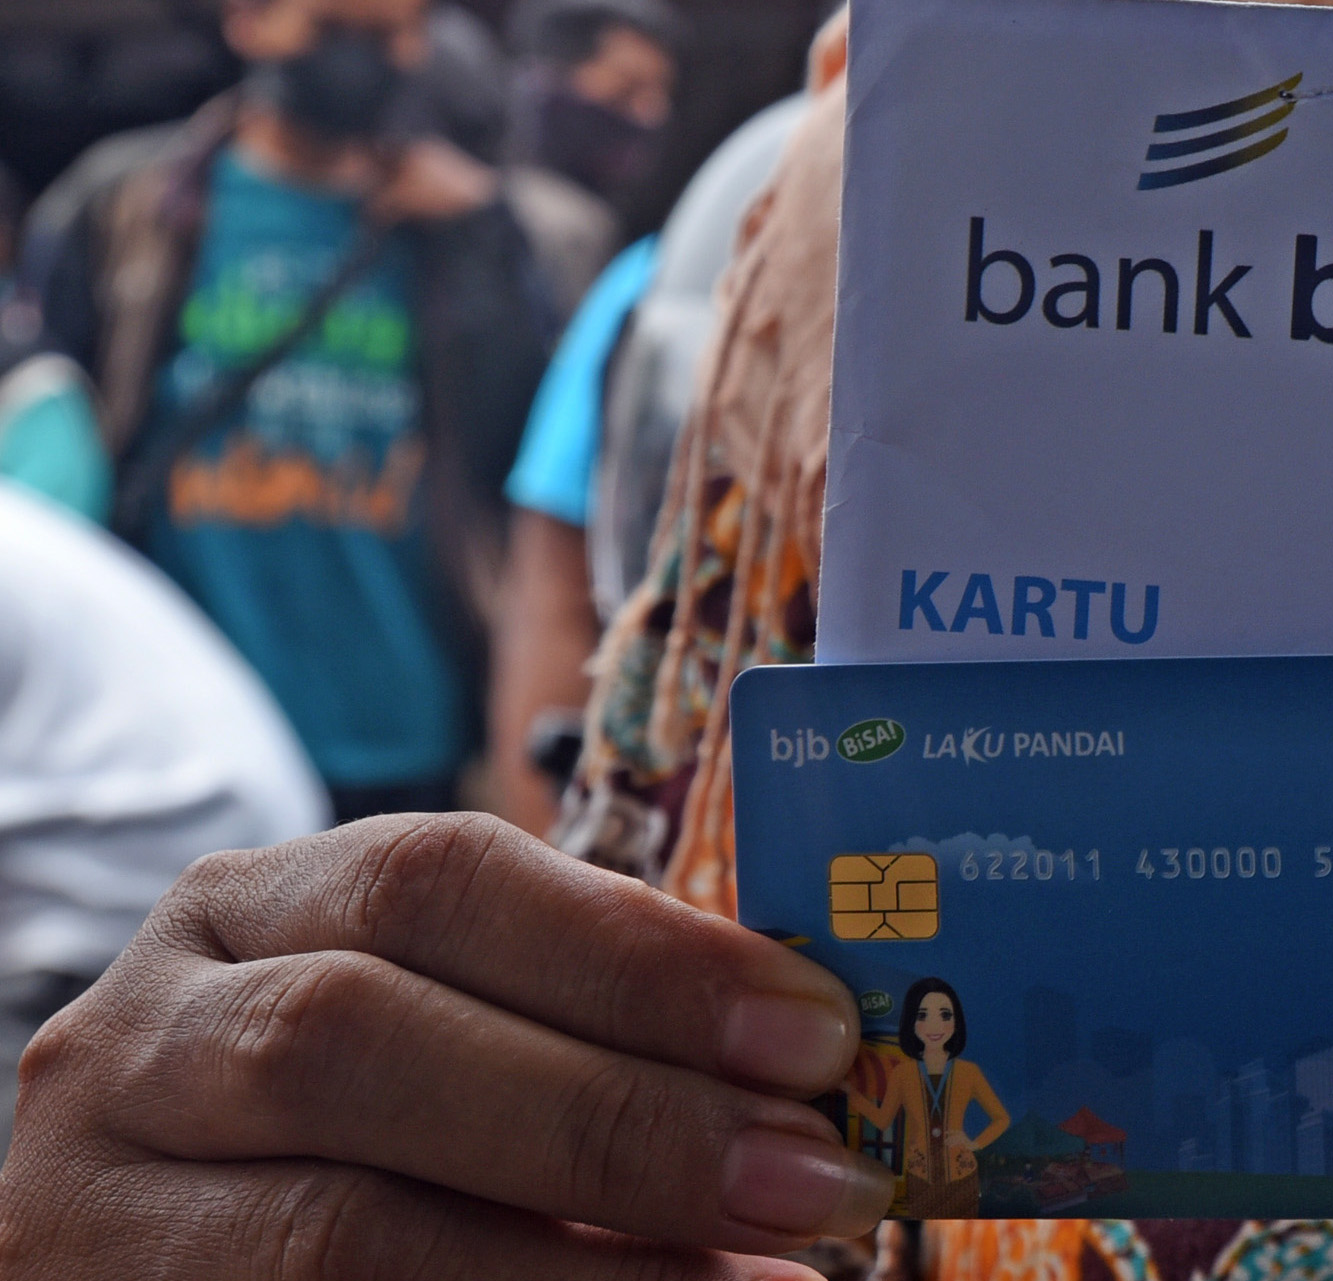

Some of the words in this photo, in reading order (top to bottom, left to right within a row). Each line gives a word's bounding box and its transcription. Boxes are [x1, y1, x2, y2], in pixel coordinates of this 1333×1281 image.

[964, 216, 1253, 340] bank
[897, 569, 1162, 646] KARTU
[769, 728, 831, 768] bjb
[922, 726, 1005, 767] LAKU
[1013, 731, 1125, 758] PANDAI
[958, 848, 1101, 882] 622011
[1135, 846, 1283, 880] 430000
